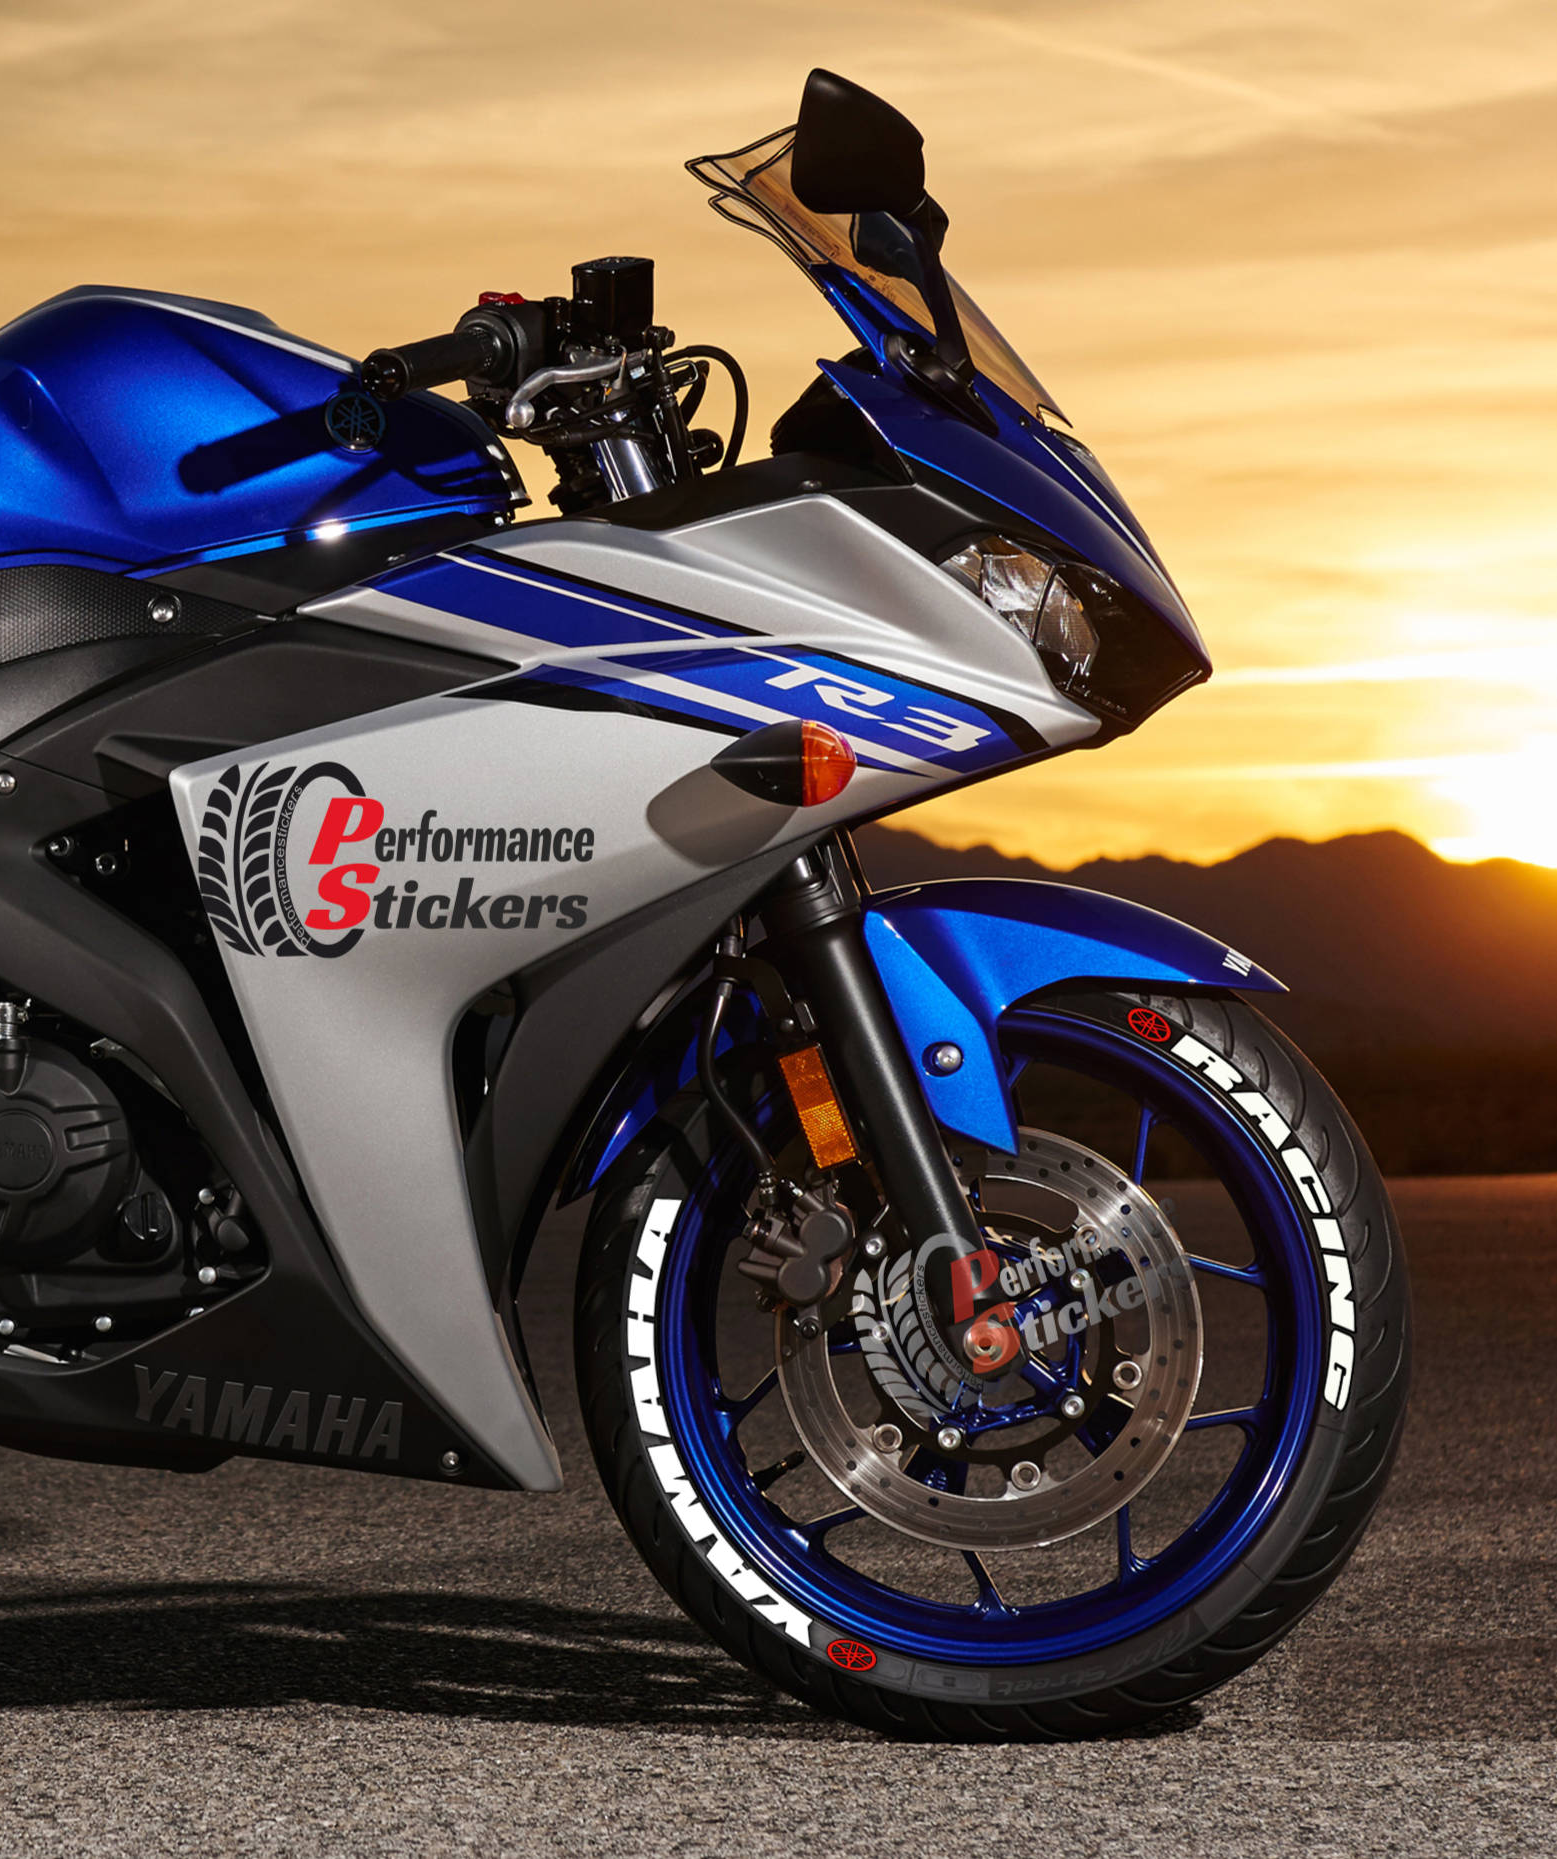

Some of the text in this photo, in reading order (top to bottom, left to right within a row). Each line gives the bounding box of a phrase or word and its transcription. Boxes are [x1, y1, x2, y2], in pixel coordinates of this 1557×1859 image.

[764, 664, 992, 752] R3
[1170, 1034, 1355, 1411] RACING
[134, 1364, 403, 1460] YAMAHA
[627, 1198, 814, 1649] YAMAHA
